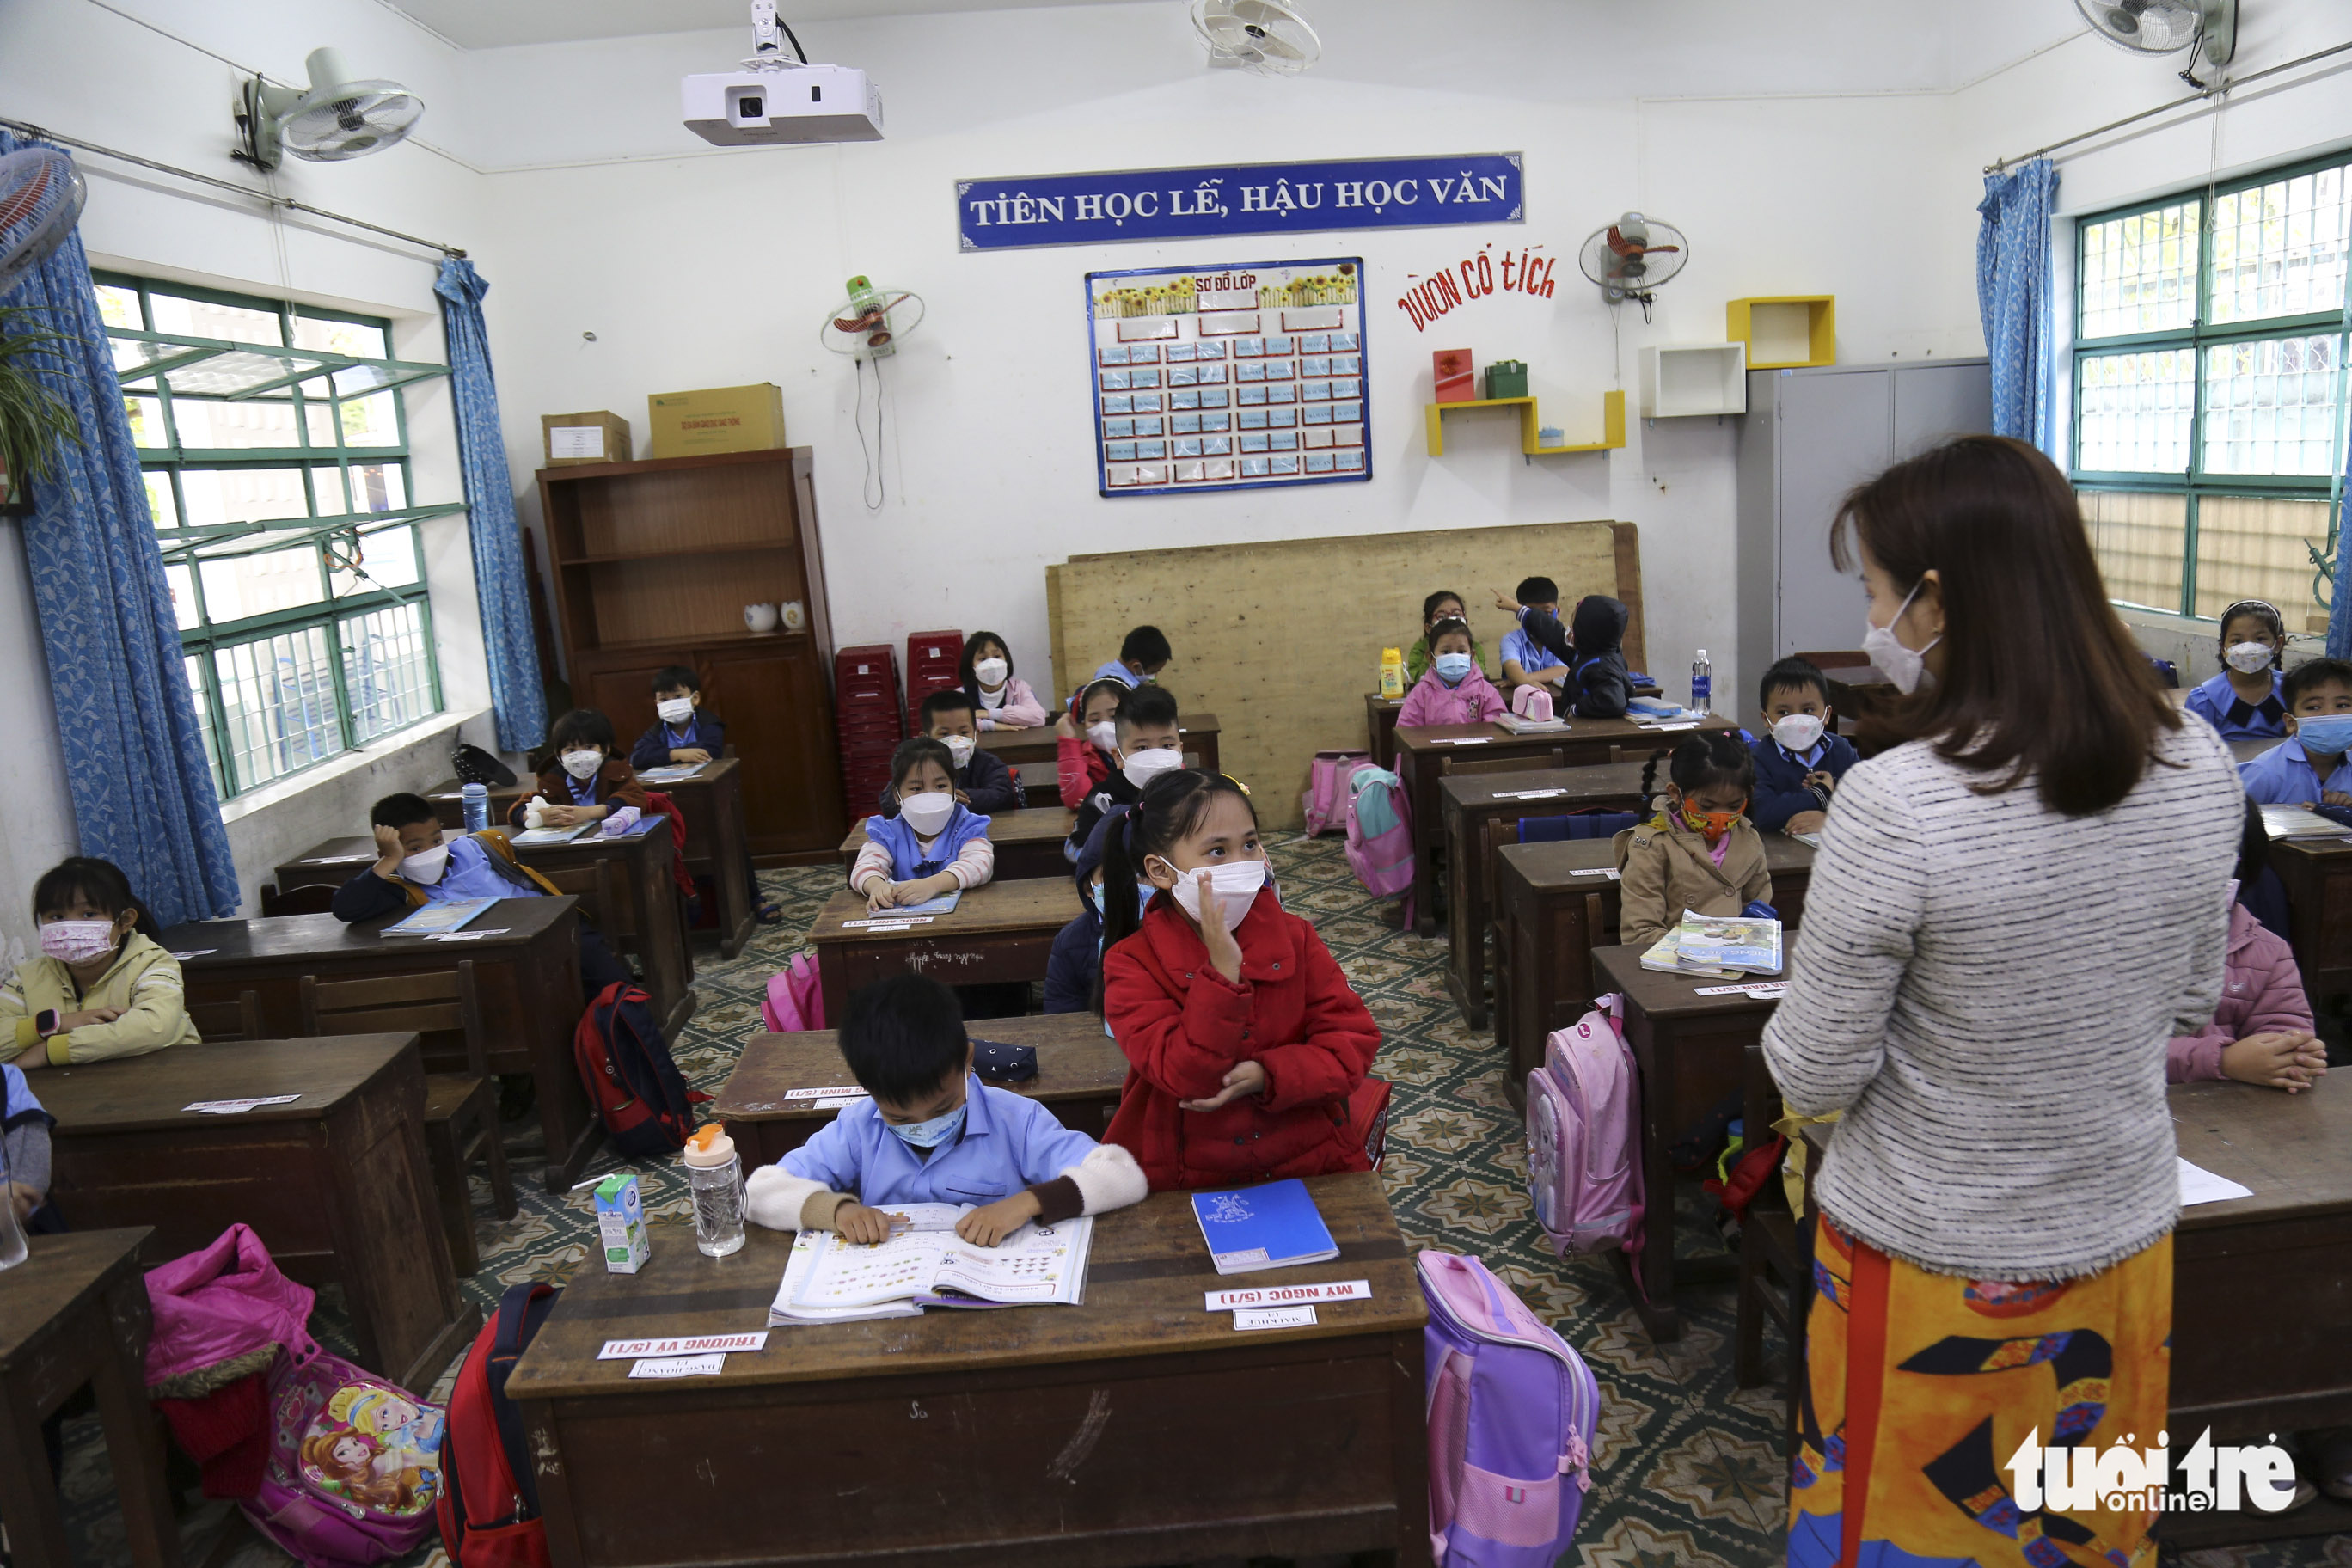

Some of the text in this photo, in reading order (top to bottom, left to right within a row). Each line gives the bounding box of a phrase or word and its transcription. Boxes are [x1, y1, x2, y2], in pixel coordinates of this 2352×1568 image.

[1074, 191, 1158, 226] HỌC
[1168, 178, 1228, 218] LỄ,
[1240, 177, 1324, 217] HẬU
[1334, 179, 1418, 214] HỌC
[1427, 170, 1507, 205] VĂN
[1233, 269, 1257, 291] LỚP
[789, 1089, 818, 1099] (5/1)
[820, 1087, 853, 1096] MINH
[1220, 1290, 1262, 1305] (5/1)
[1269, 1287, 1320, 1302] NGỌC
[608, 1341, 652, 1355] (5/1)
